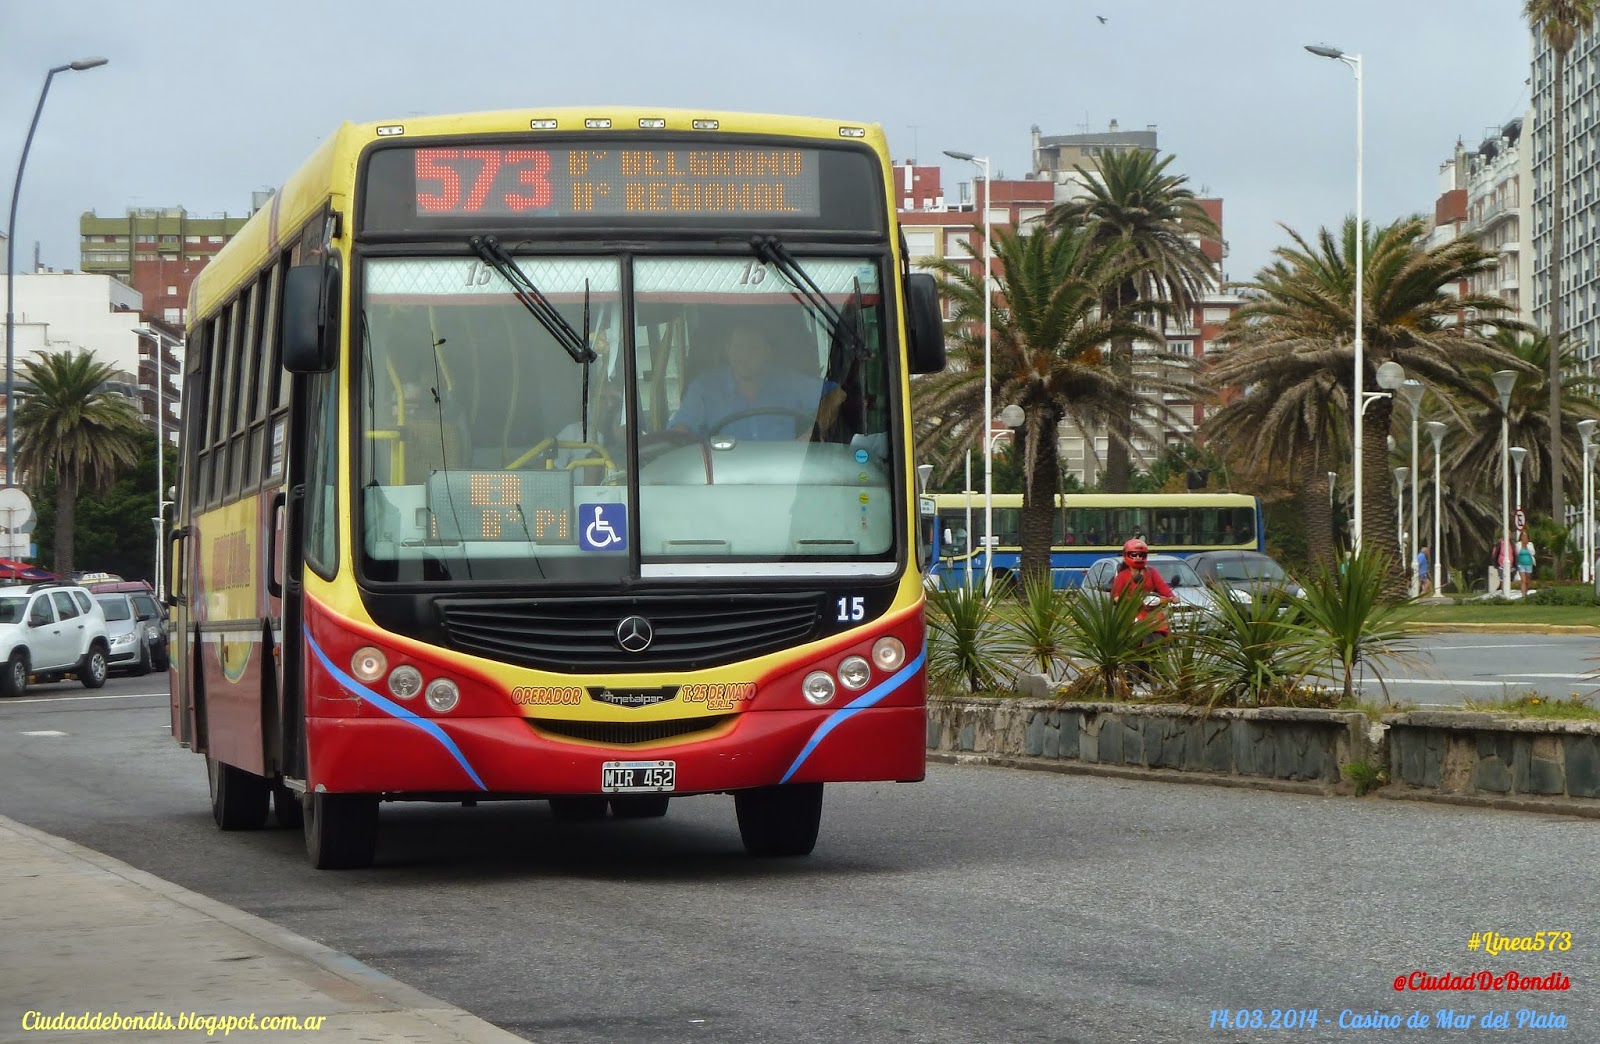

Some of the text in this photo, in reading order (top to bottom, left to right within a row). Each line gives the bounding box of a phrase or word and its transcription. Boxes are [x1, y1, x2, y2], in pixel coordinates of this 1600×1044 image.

[416, 149, 551, 210] 573
[626, 182, 796, 210] REGIONAL
[465, 260, 491, 286] 15
[740, 260, 766, 285] 15
[838, 597, 865, 621] 15
[512, 686, 582, 705] OPERADOR
[605, 693, 664, 705] metalpar
[692, 684, 708, 702] 25
[707, 684, 724, 702] DE
[724, 682, 757, 701] MAYO
[605, 769, 673, 787] MIR 452
